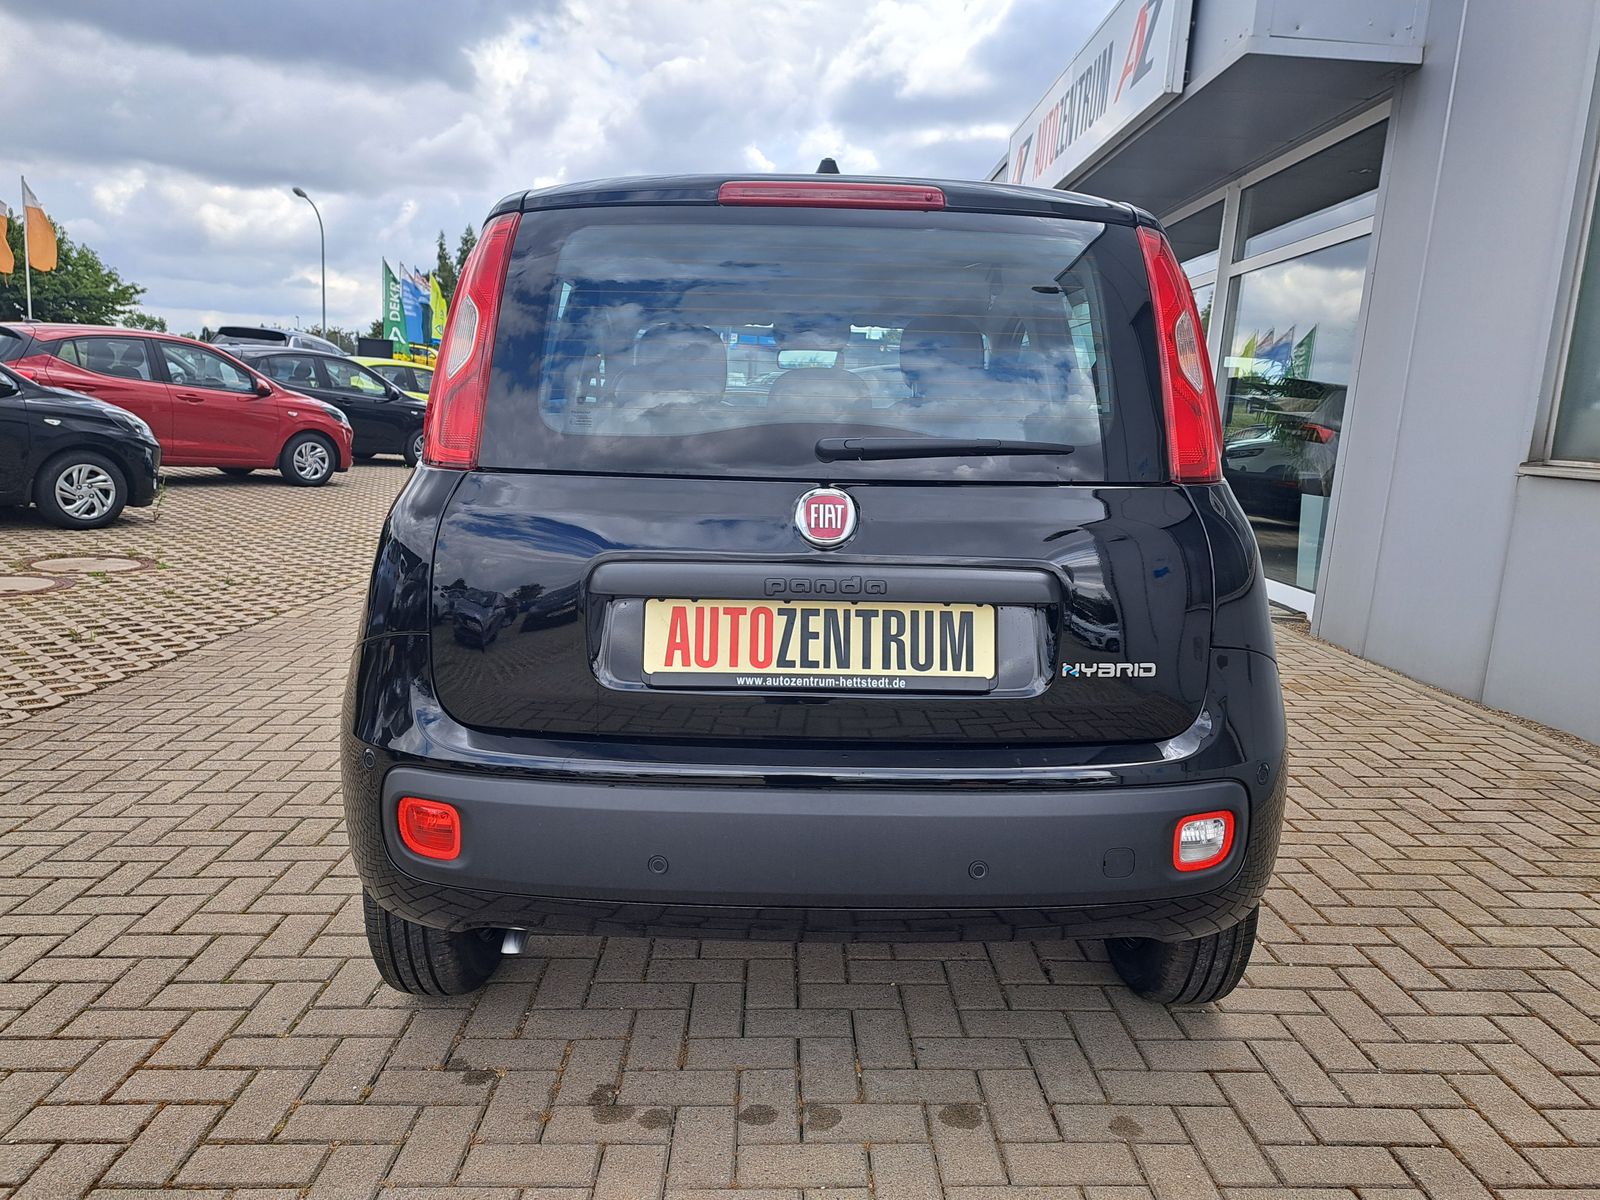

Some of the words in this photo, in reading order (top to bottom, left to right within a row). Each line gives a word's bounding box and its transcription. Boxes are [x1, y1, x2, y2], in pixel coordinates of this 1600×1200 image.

[1032, 40, 1114, 181] AUTOZENTRUM
[1113, 0, 1163, 105] AZ
[389, 281, 401, 322] DEKR
[810, 504, 845, 529] FIAT
[764, 576, 887, 596] panda
[663, 606, 974, 672] AUTOZENTRUM
[736, 675, 906, 689] www.autozentrum-hettstedt.de
[1062, 663, 1156, 677] HYBRID
